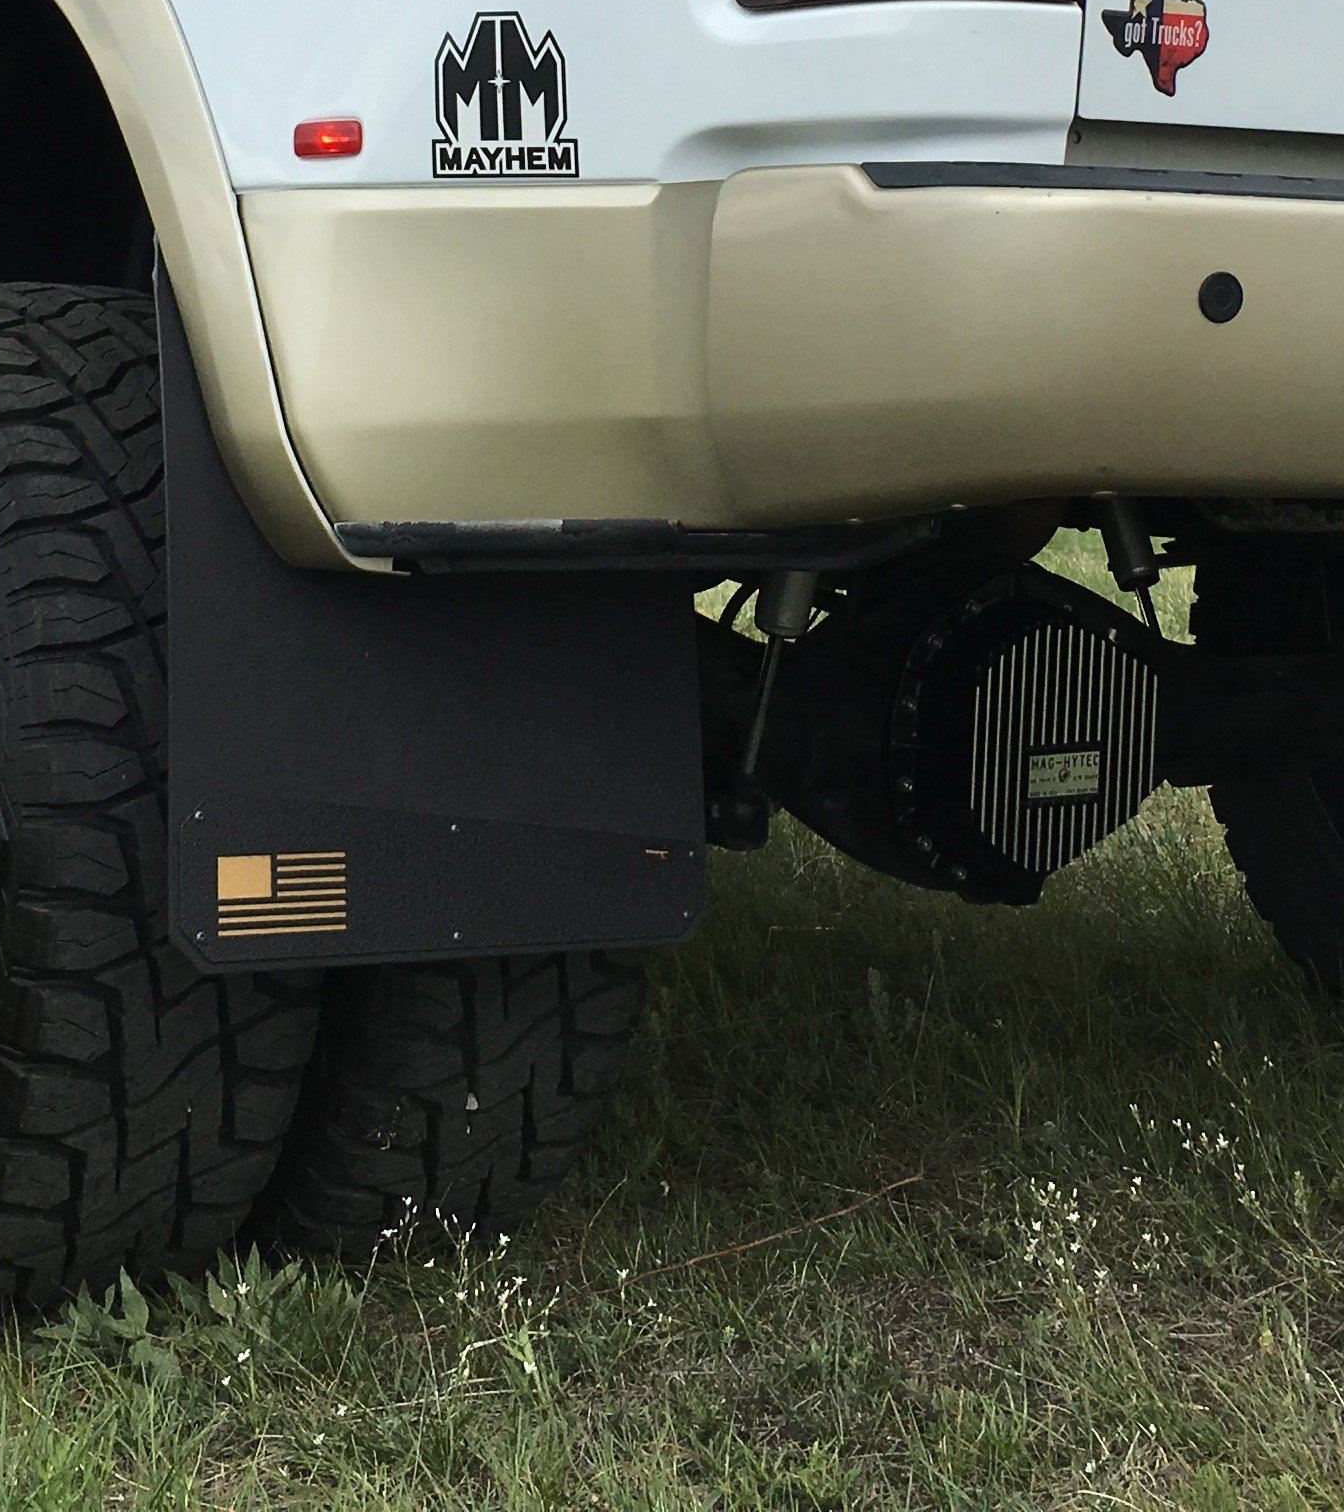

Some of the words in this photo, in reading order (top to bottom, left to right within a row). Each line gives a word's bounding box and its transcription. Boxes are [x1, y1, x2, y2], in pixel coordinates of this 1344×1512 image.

[1124, 18, 1147, 48] got
[1151, 17, 1203, 48] Trucks?
[439, 146, 573, 171] MAYHEM
